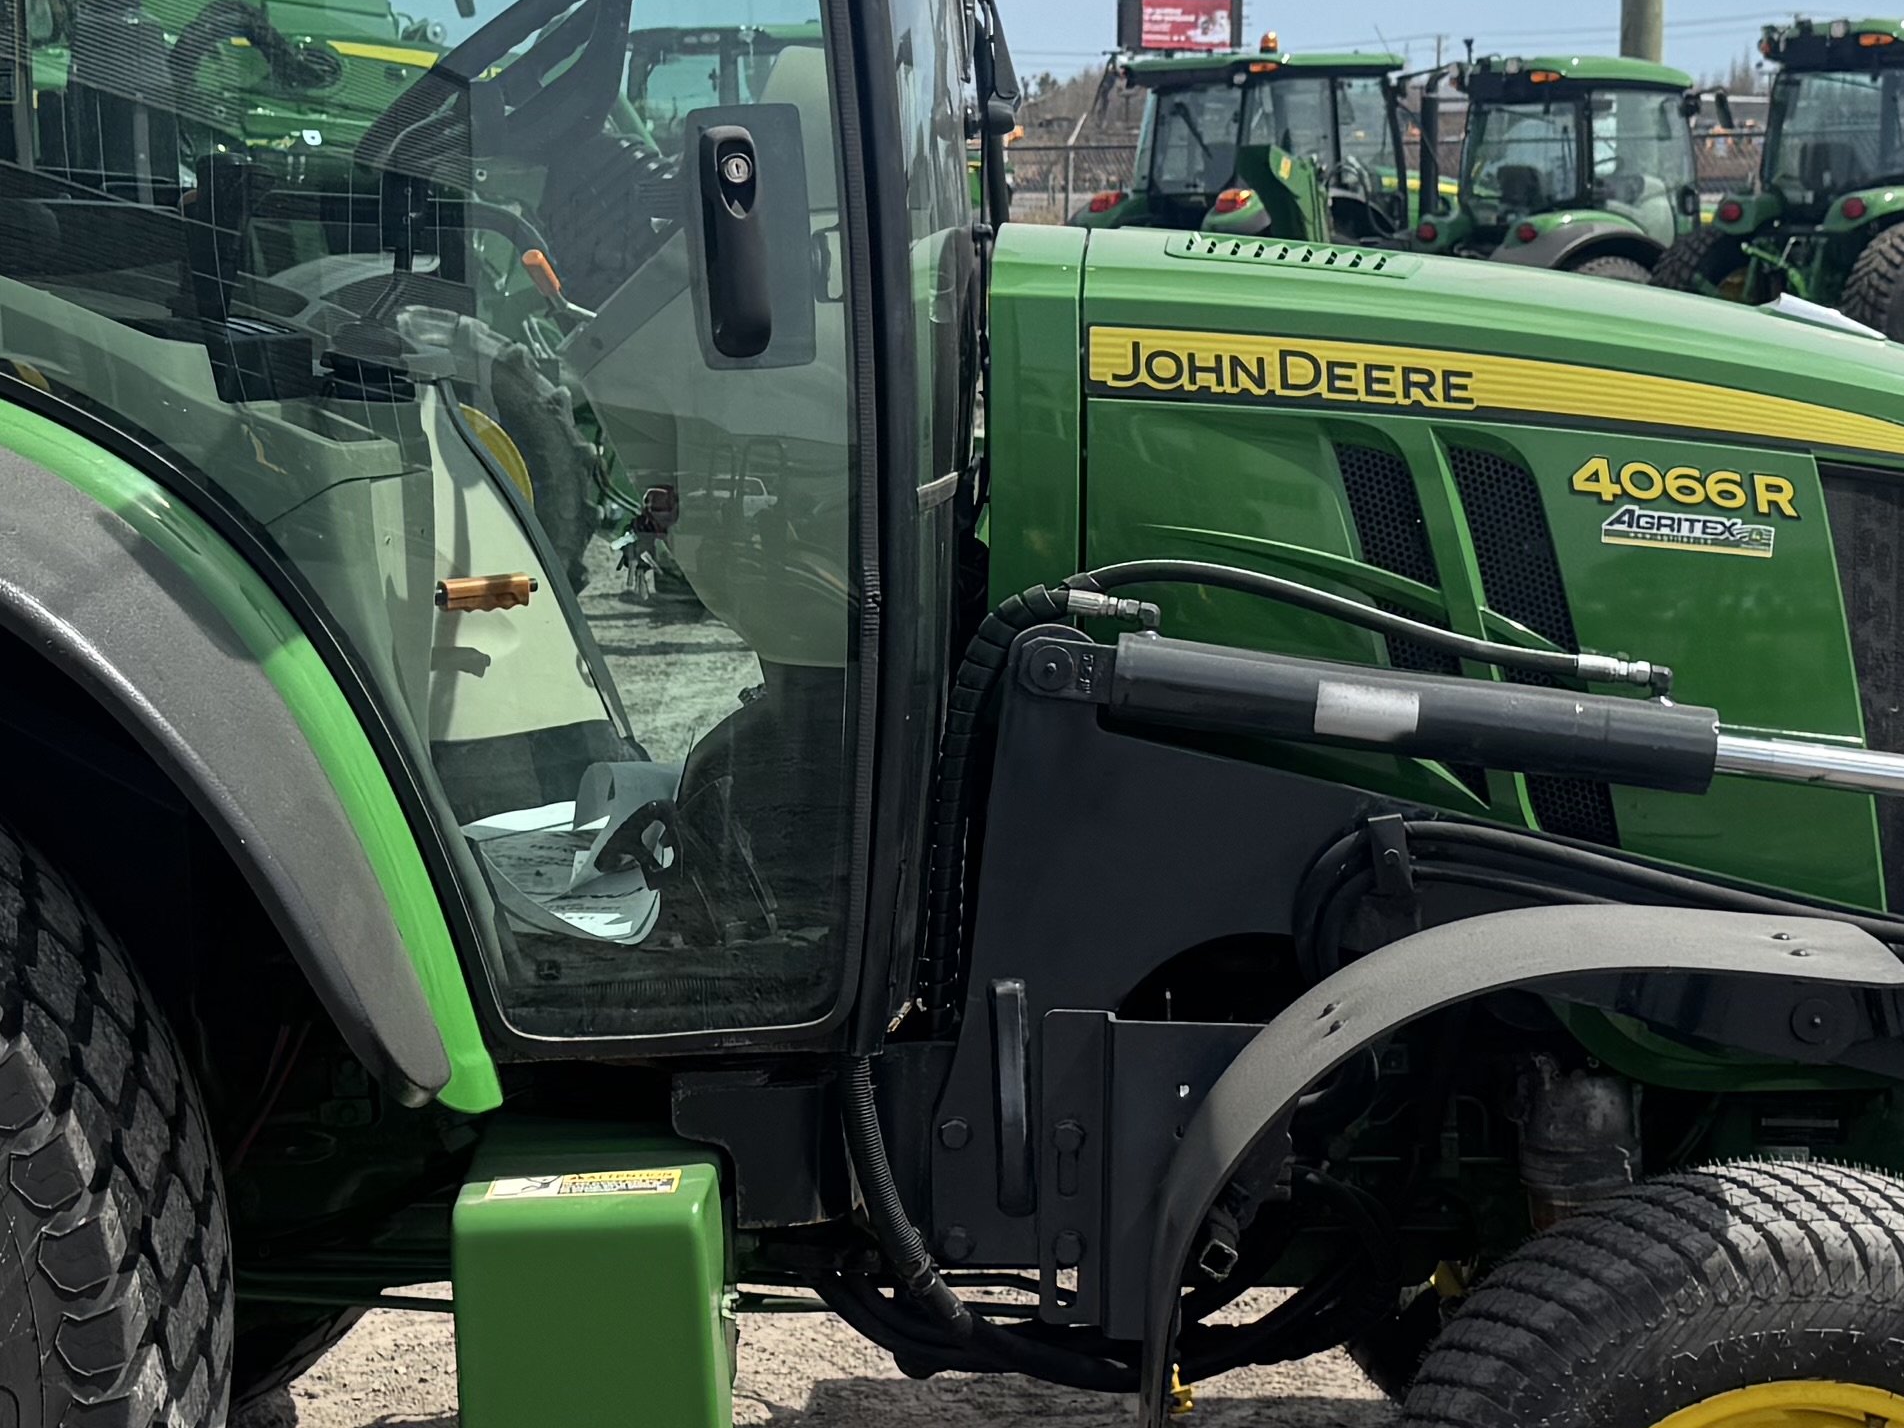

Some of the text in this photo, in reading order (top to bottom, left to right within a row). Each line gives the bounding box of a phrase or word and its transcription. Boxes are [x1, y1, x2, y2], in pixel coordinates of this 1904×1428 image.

[1111, 340, 1475, 405] JOHN DEERE
[1605, 508, 1739, 540] AGRITEX
